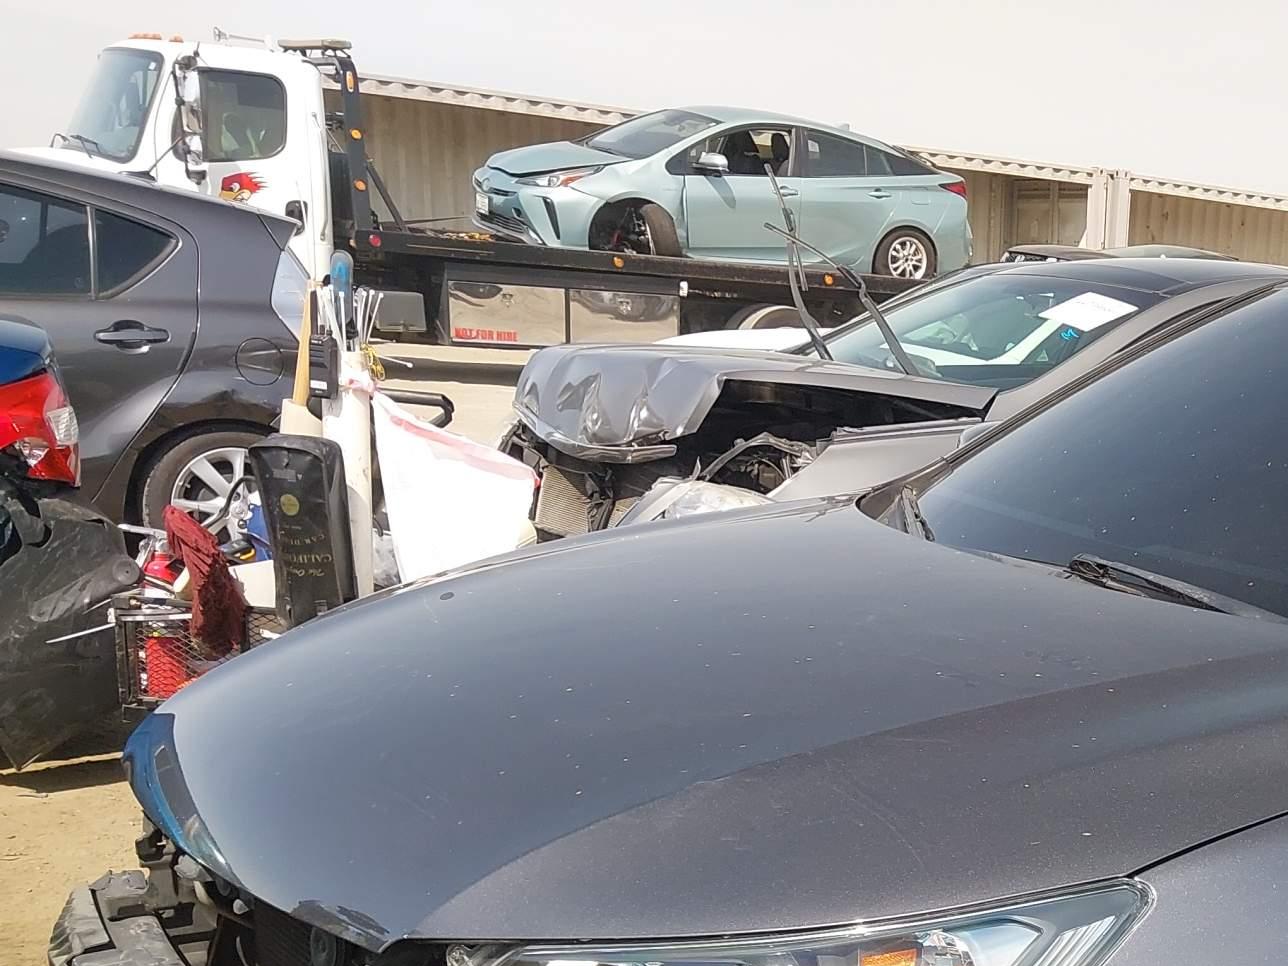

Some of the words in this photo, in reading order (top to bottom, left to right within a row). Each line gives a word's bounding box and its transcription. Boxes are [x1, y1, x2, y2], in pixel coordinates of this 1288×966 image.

[454, 327, 473, 339] NOT
[476, 329, 494, 341] FOR
[496, 331, 518, 342] HIRE
